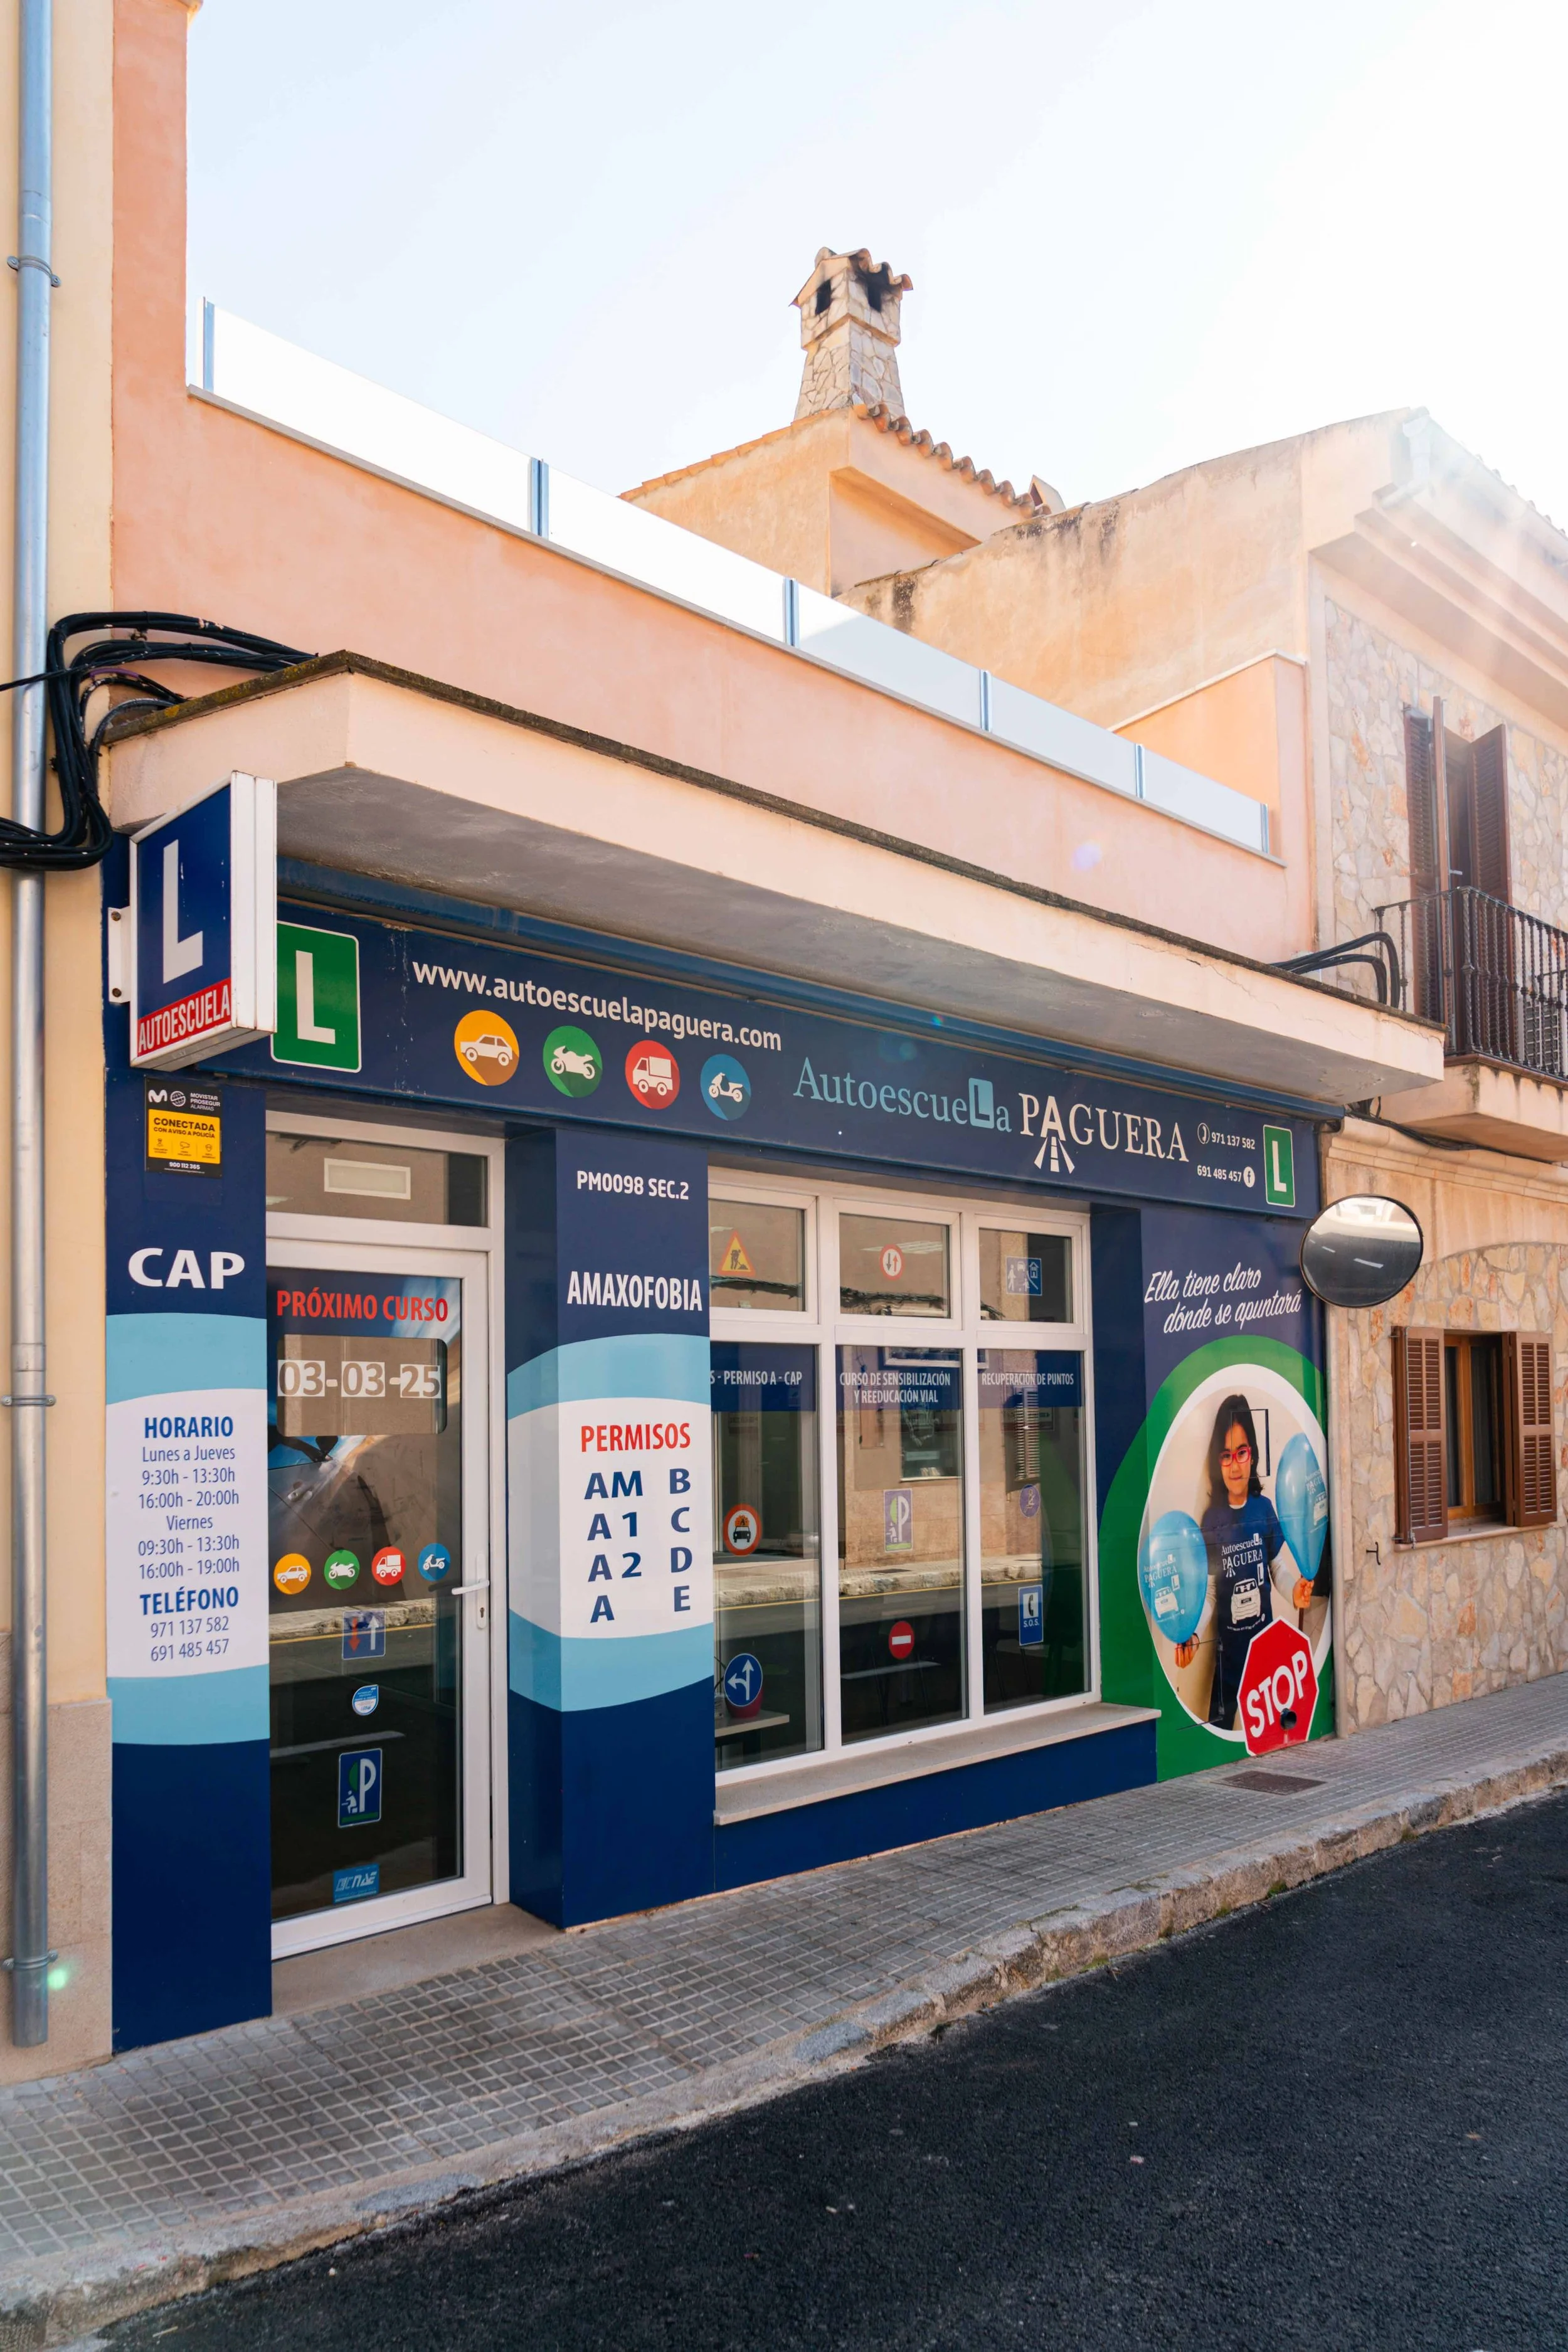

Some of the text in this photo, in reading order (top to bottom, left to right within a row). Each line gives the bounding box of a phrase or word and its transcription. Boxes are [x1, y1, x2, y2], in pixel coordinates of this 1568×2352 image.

[164, 840, 203, 983] L
[296, 950, 336, 1044] L
[412, 961, 781, 1051] www.autoescuelapaguera.com
[137, 985, 230, 1053] AUTOESCUELA
[190, 1099, 220, 1107] PROSEGUR
[154, 1117, 215, 1131] CONECTADA
[1018, 1093, 1189, 1163] PAGUERA
[1211, 1131, 1255, 1150] 971 137 582
[1197, 1165, 1211, 1177] 691
[1213, 1168, 1227, 1180] 485
[1228, 1171, 1242, 1182] 457
[1272, 1140, 1286, 1192] L
[577, 1170, 689, 1200] PM0098 SEC.2
[129, 1248, 245, 1290] CAP
[567, 1271, 702, 1311] AMAXOFOBIA
[1144, 1262, 1261, 1303] Ella tiene claro
[277, 1286, 448, 1322] PRÓXIMO CURSO
[1163, 1289, 1303, 1333] dónde se apuntará
[278, 1360, 442, 1399] 03-03-25
[724, 1370, 767, 1385] PERMISO
[770, 1371, 776, 1385] A
[784, 1371, 802, 1385] CAP
[839, 1371, 950, 1386] CURSO DE SENSIBILIZACIÓN
[982, 1372, 1074, 1385] RECUPERACIÓN DE PUNTOS
[854, 1388, 938, 1404] Y REEDUCACIÓN VIAL
[144, 1416, 233, 1438] HORARIO
[581, 1422, 691, 1453] PERMISOS
[142, 1445, 235, 1462] Lunes a Jueves
[142, 1468, 179, 1486] 9:30h
[193, 1467, 235, 1483] 13:30h
[584, 1468, 691, 1500] AM B
[139, 1493, 183, 1509] 16:00h
[196, 1490, 240, 1506] 20:00h
[166, 1515, 213, 1530] Viernes
[670, 1507, 690, 1533] C
[138, 1538, 183, 1556] 09:30h
[197, 1535, 240, 1552] 13:30h
[139, 1562, 183, 1580] 16:00h
[197, 1557, 240, 1574] 19:00h
[670, 1547, 692, 1573] D
[1222, 1549, 1263, 1571] PAGUERA
[1144, 1565, 1177, 1583] PAGUERA
[140, 1586, 239, 1615] TELÉFONO
[590, 1586, 691, 1623] A E
[151, 1616, 229, 1638] 971 137 582
[1024, 1618, 1039, 1628] S.O.S.
[151, 1639, 229, 1661] 691 485 457
[1246, 1650, 1308, 1738] STOP
